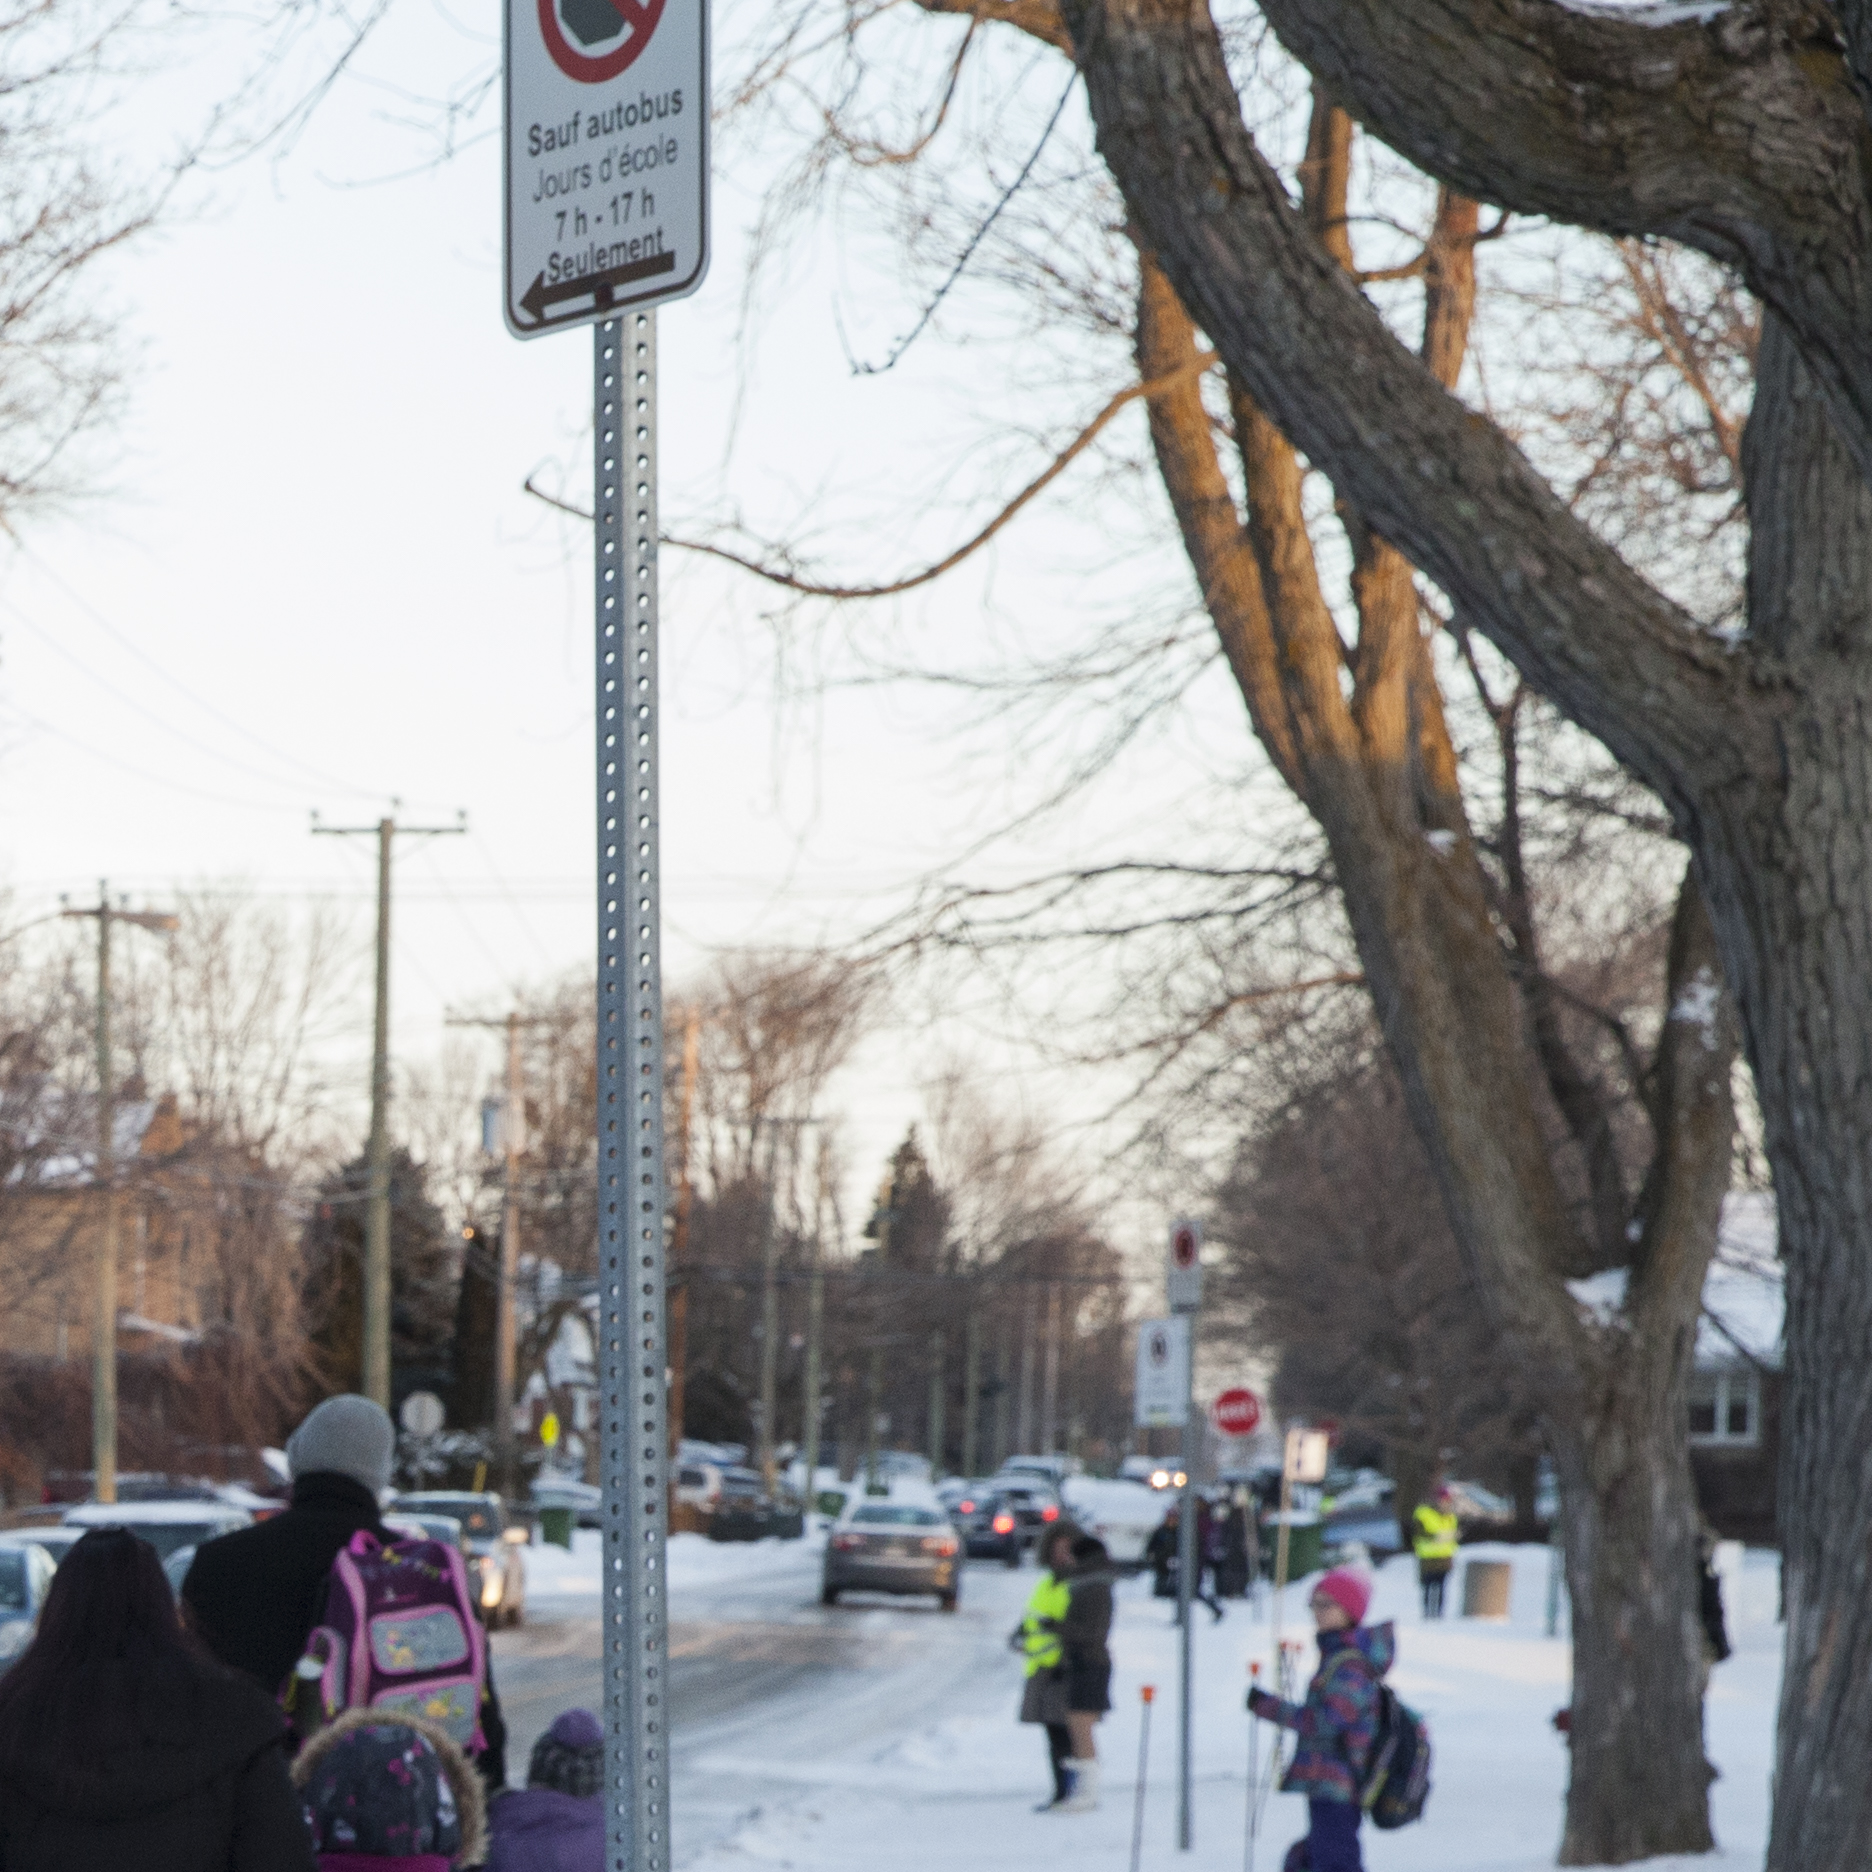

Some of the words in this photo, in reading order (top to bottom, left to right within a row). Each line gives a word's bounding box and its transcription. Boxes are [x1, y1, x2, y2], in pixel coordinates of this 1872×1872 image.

[528, 111, 581, 157] Sauf
[587, 89, 684, 139] autobus
[533, 164, 592, 203] Jours
[599, 133, 678, 183] d'école
[555, 211, 567, 242] 7
[574, 206, 587, 237] h
[609, 191, 634, 226] 17
[641, 187, 655, 217] h
[547, 226, 664, 283] Seulement
